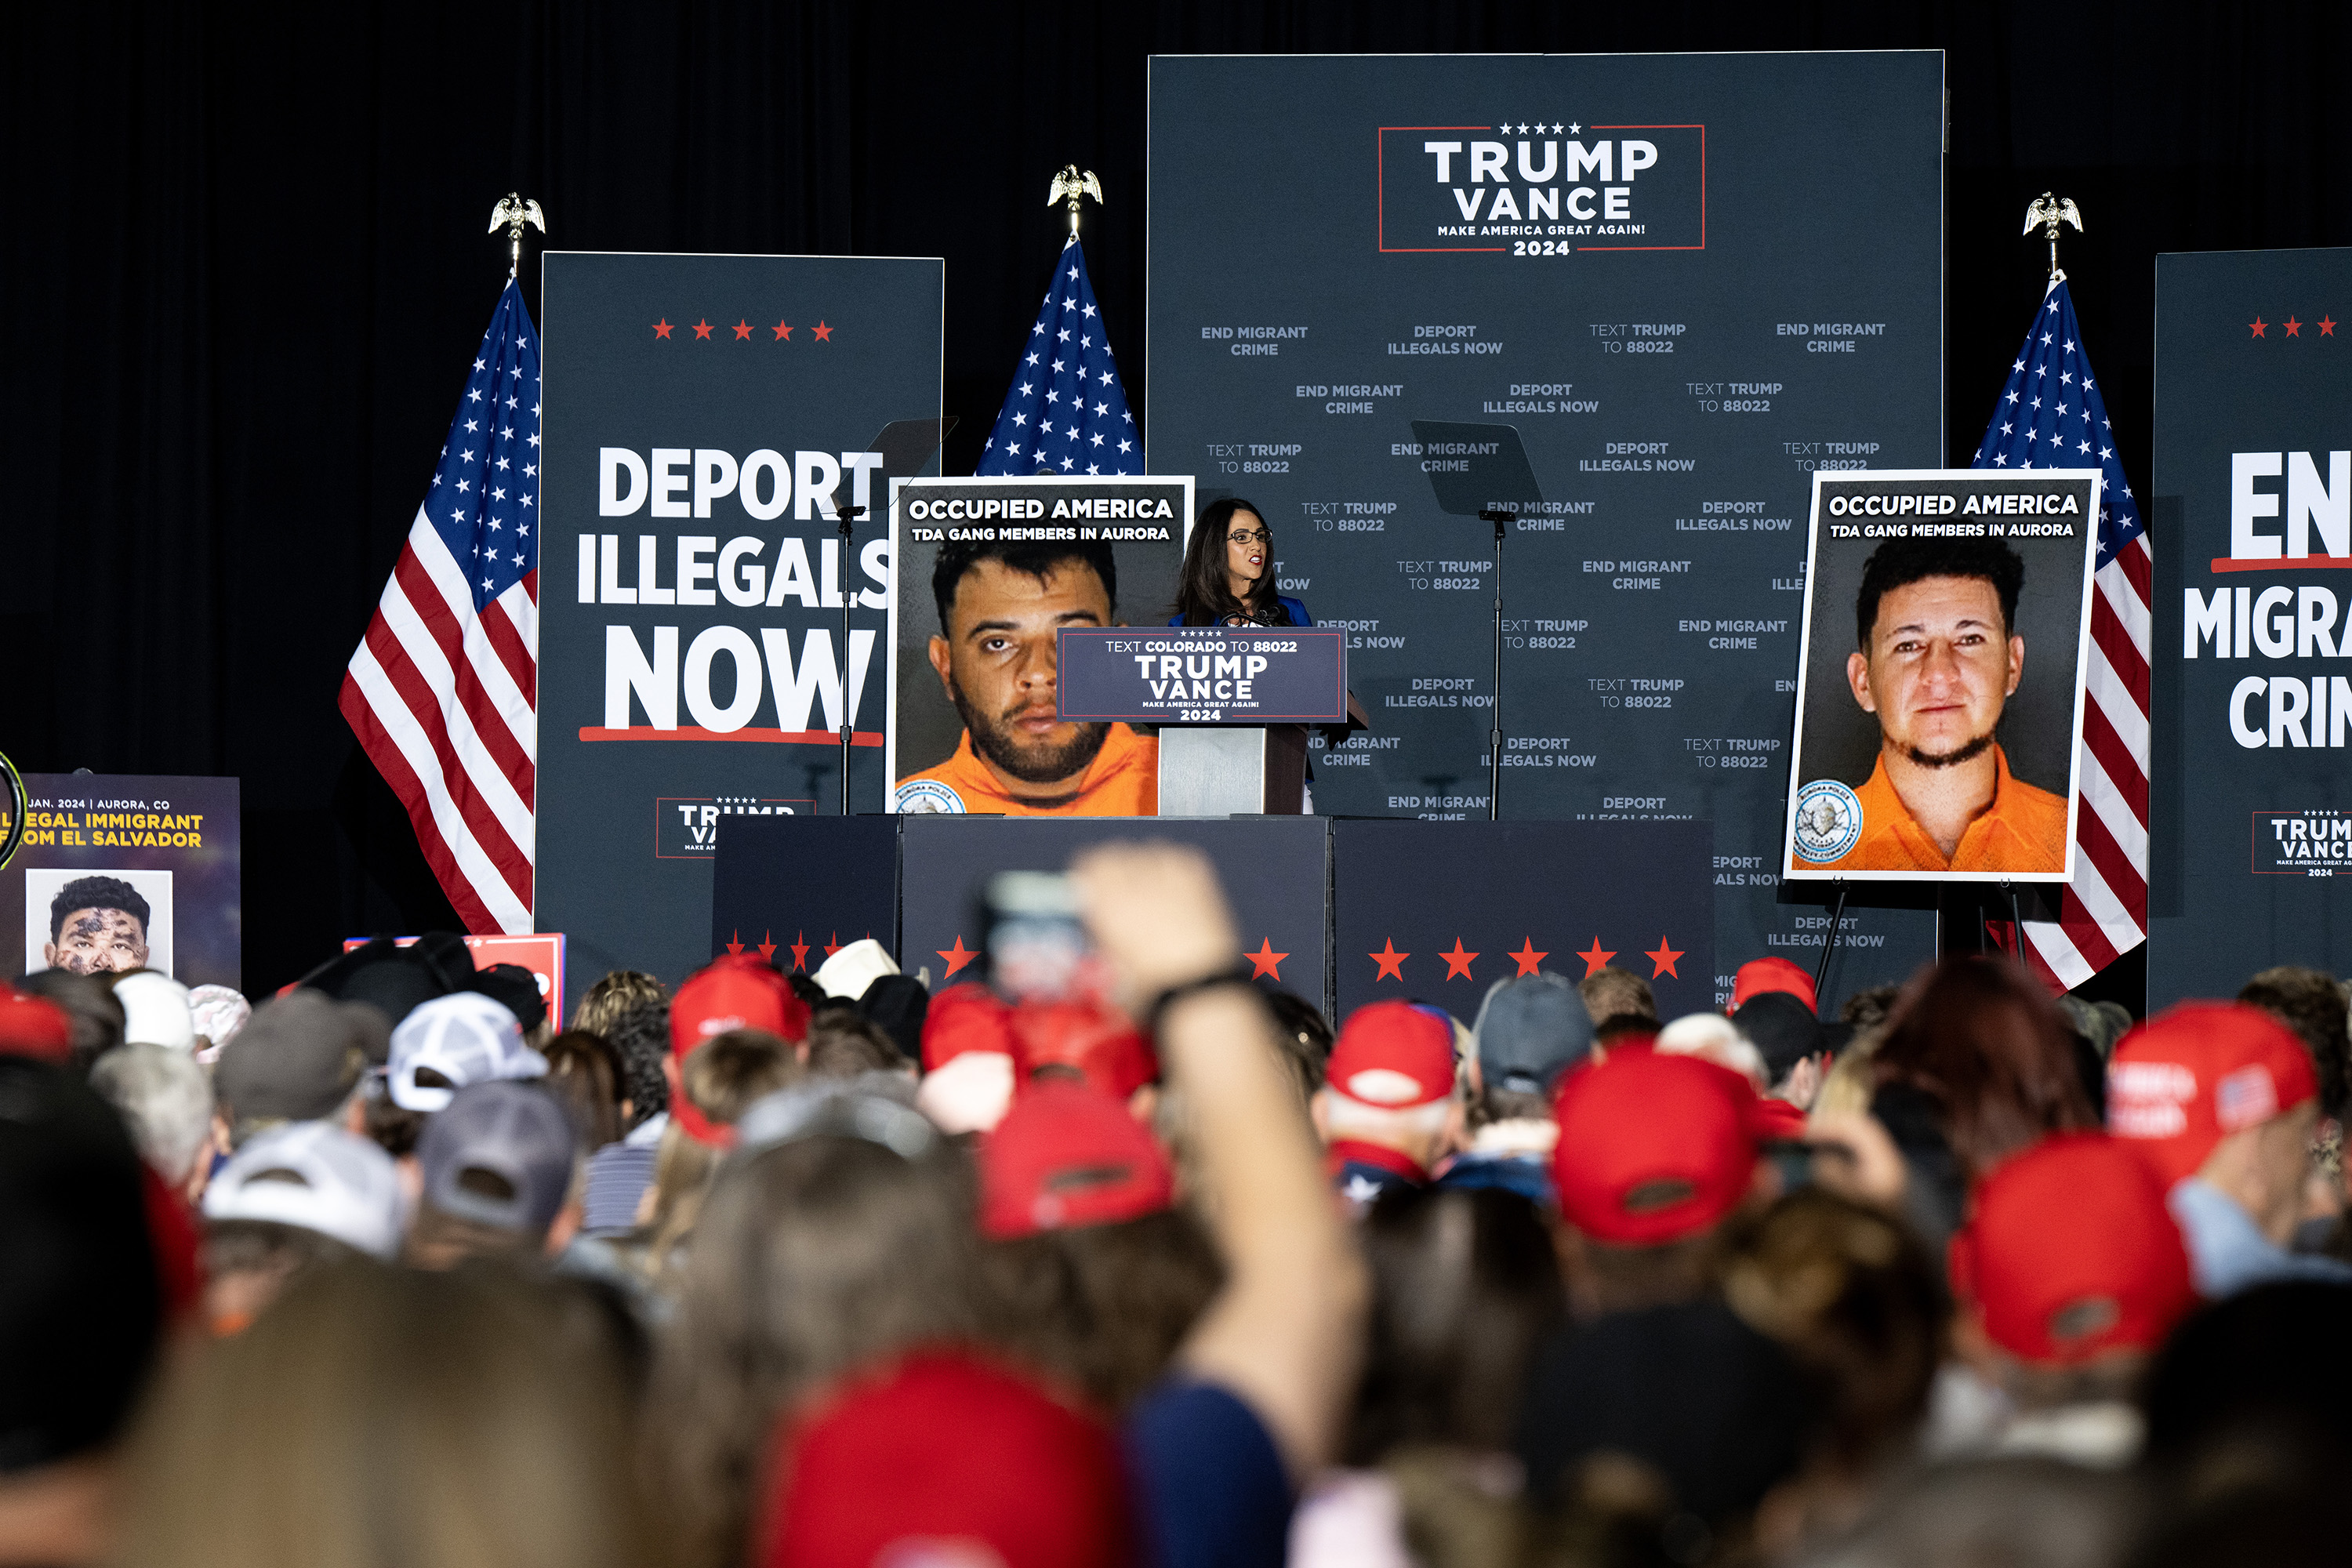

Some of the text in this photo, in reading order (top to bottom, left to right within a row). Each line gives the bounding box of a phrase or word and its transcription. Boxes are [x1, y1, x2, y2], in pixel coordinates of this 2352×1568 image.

[1425, 140, 1657, 183] TRUMP
[1454, 187, 1630, 220] VANCE
[1439, 225, 1645, 235] MAKE AMERICA GREAT AGAIN!
[1514, 241, 1569, 256] 2024
[1202, 327, 1308, 338] END MIGRANT
[1415, 326, 1476, 337] DEPORT
[1590, 325, 1686, 336] TEXT TRUMP
[1777, 324, 1886, 335] END MIGRANT
[1231, 344, 1278, 355] CRIME
[1388, 343, 1502, 354] ILLEGALS NOW
[1602, 341, 1673, 353] TO 88022
[1807, 341, 1855, 352] CRIME
[1297, 385, 1403, 397] END MIGRANT
[1511, 384, 1572, 395] DEPORT
[1686, 383, 1782, 394] TEXT TRUMP
[1326, 402, 1373, 413] CRIME
[1484, 401, 1599, 412] ILLEGALS NOW
[1699, 401, 1769, 412] TO 88022
[1207, 445, 1301, 456] TEXT TRUMP
[1392, 444, 1498, 455] END MIGRANT
[1606, 443, 1668, 454] DEPORT
[1784, 443, 1879, 454] TEXT TRUMP
[1219, 462, 1289, 473] TO 88022
[1421, 460, 1468, 472] CRIME
[1580, 460, 1695, 471] ILLEGALS NOW
[1796, 460, 1867, 471] TO 88022
[600, 448, 883, 521] DEPORT
[909, 499, 1173, 519] OCCUPIED AMERICA
[1302, 503, 1396, 514] TEXT TRUMP
[1488, 503, 1595, 514] END MIGRANT
[1703, 502, 1765, 513] DEPORT
[1830, 495, 2078, 515] OCCUPIED AMERICA
[2231, 451, 2351, 560] EN
[1314, 520, 1384, 531] TO 88022
[1517, 519, 1564, 530] CRIME
[1676, 519, 1791, 530] ILLEGALS NOW
[913, 528, 1169, 540] TDA GANG MEMBERS IN AURORA
[1831, 524, 2073, 537] TDA GANG MEMBERS IN AURORA
[579, 534, 888, 610] ILLEGALS
[1397, 561, 1492, 572] TEXT TRUMP
[1584, 561, 1691, 572] END MIGRANT
[1276, 579, 1310, 590] NOW
[1409, 579, 1479, 590] TO 88022
[1613, 578, 1661, 589] CRIME
[1773, 579, 1802, 590] ILLE
[1493, 620, 1588, 631] EXT TRUMP
[1679, 620, 1788, 632] END MIGRANT
[2184, 586, 2352, 658] MIGR
[1106, 641, 1297, 652] TEXT COLORADO TO 88022
[1367, 637, 1405, 648] NOW
[1504, 637, 1575, 648] TO 88022
[1709, 637, 1757, 648] CRIME
[1135, 655, 1267, 679] TRUMP
[604, 626, 876, 733] NOW
[1413, 679, 1474, 690] DEPORT
[1588, 679, 1684, 691] TEXT TRUMP
[1149, 681, 1251, 699] VANCE
[1776, 681, 1795, 691] EN
[1386, 696, 1457, 706] ILLEGALS
[1601, 696, 1671, 707] TO 88022
[1181, 710, 1221, 720] 2024
[2230, 677, 2352, 748] CRI
[1308, 738, 1325, 748] ND
[1508, 739, 1570, 749] DEPORT
[1684, 739, 1780, 750] TEXT TRUMP
[1323, 755, 1370, 765] CRIME
[1482, 756, 1596, 767] ILEGALS NOW
[1697, 756, 1767, 768] TO 88022
[28, 799, 53, 808] JAN.
[97, 800, 149, 810] AURORA,
[154, 800, 169, 810] CO
[1388, 797, 1420, 808] END
[1604, 797, 1666, 808] DEPORT
[0, 811, 202, 829] LEGAL IMMIGRANT
[2271, 819, 2351, 840] TRUM
[0, 830, 201, 848] FOM EL SALVADOR
[1713, 857, 1762, 868] EPORT
[1846, 935, 1885, 947] NOW
